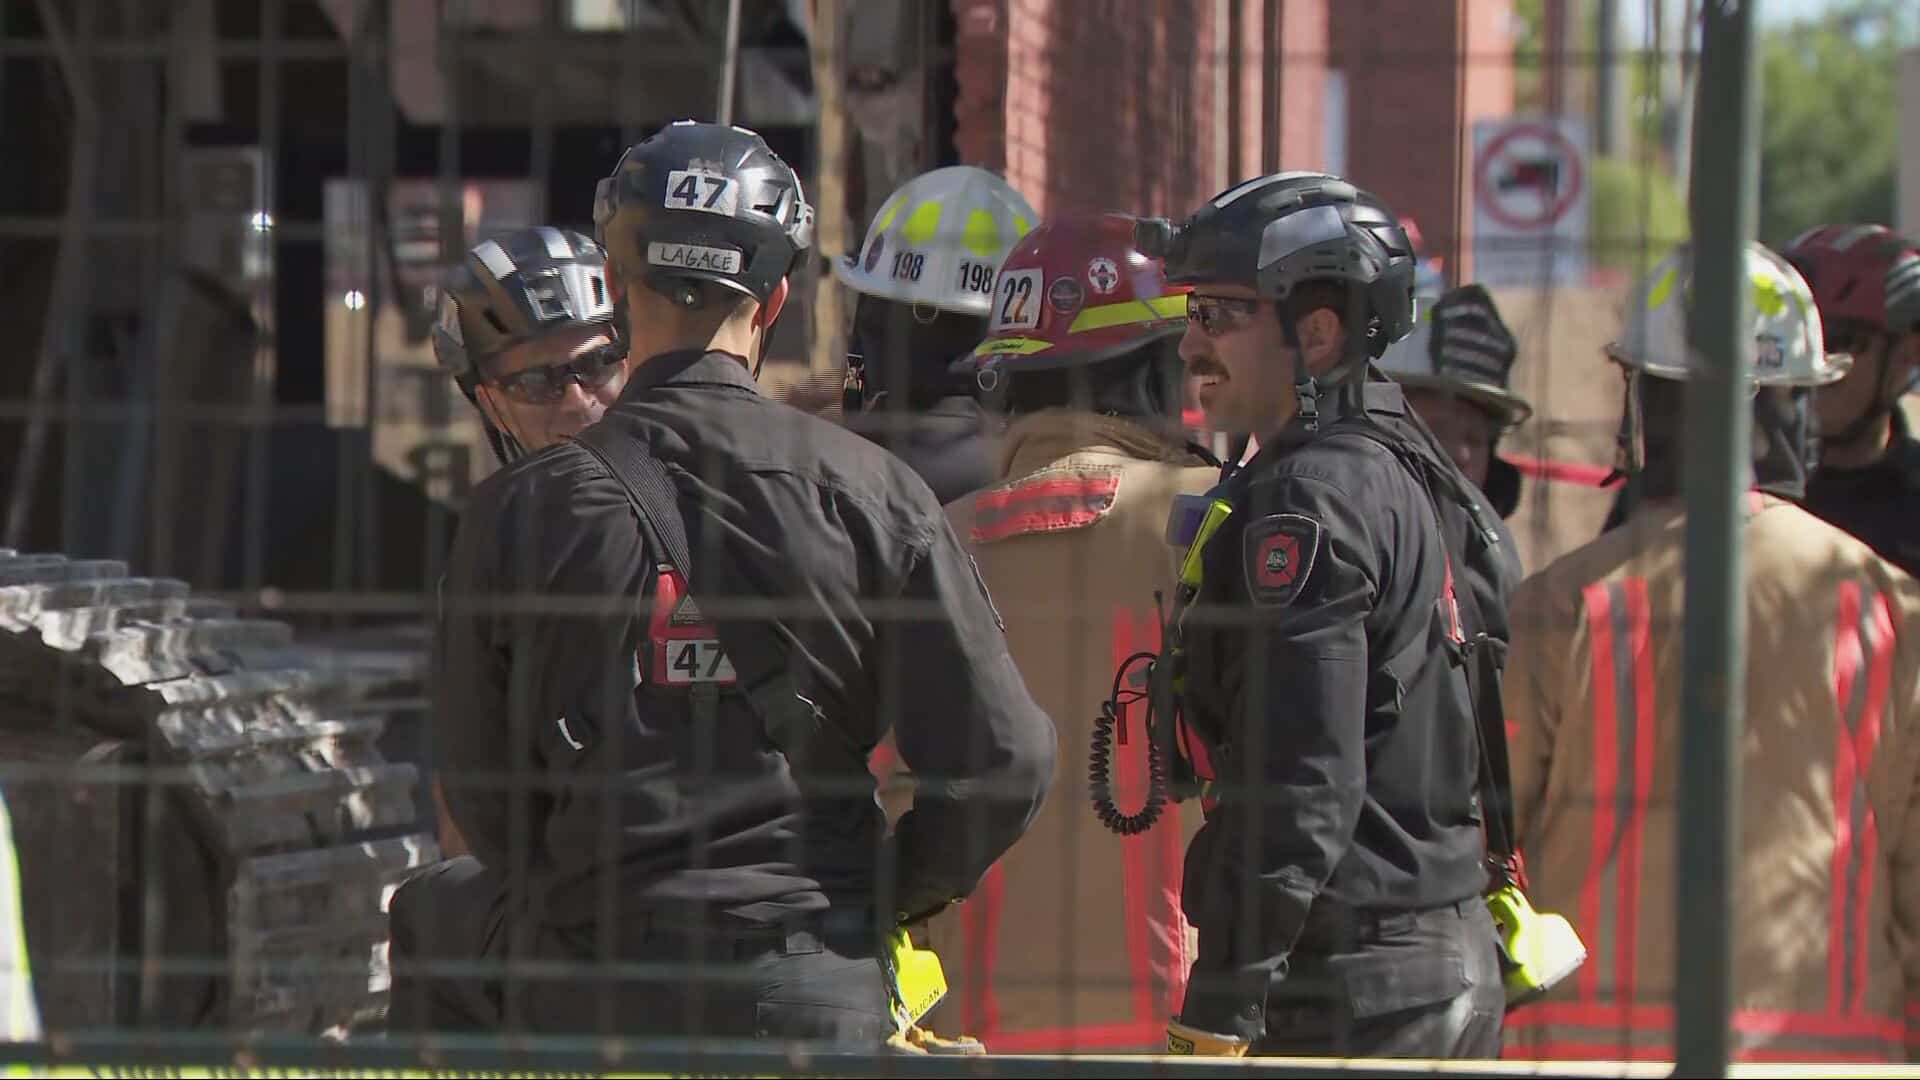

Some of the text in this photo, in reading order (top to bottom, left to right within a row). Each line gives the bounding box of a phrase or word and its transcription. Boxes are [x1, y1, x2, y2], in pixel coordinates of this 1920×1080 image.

[672, 175, 728, 208] 47
[892, 251, 924, 281] 198
[960, 261, 993, 294] 198
[1001, 276, 1033, 324] 22
[673, 643, 724, 678] 47
